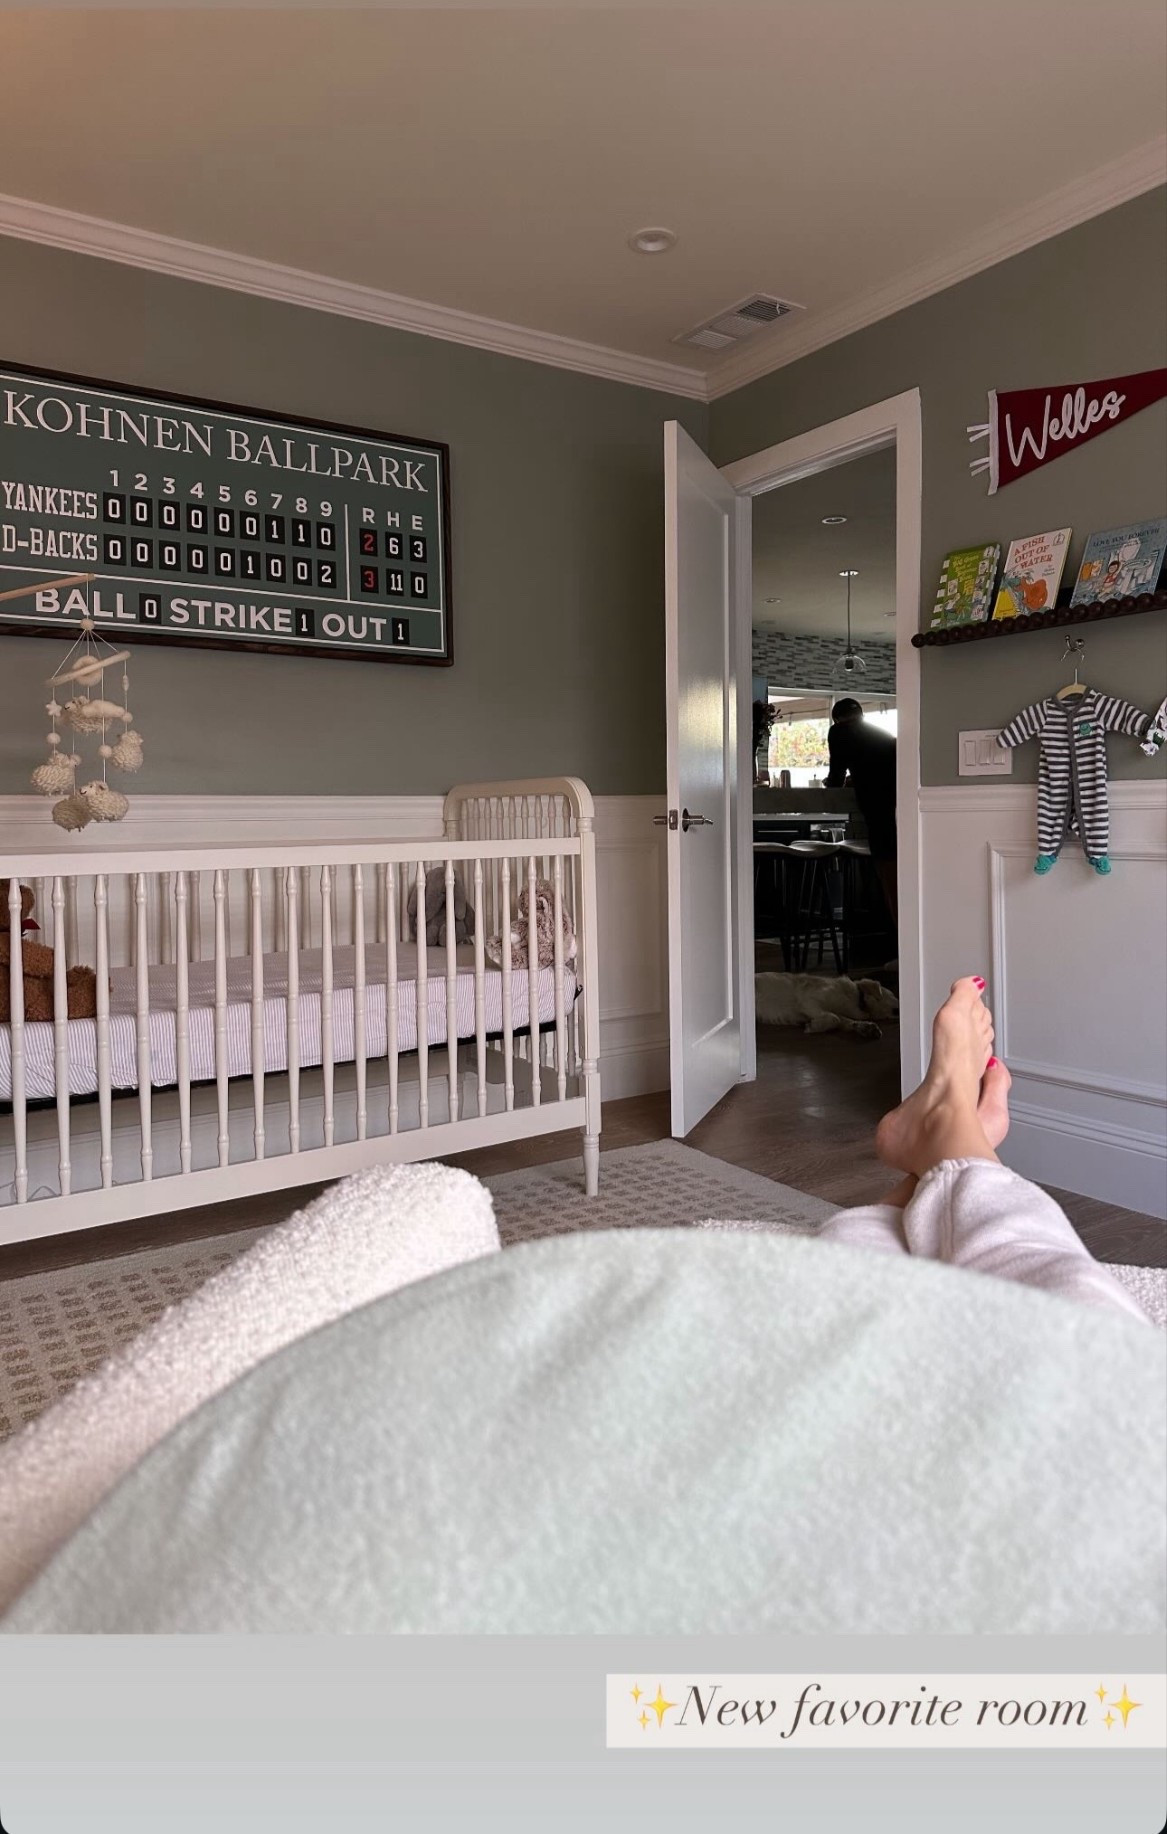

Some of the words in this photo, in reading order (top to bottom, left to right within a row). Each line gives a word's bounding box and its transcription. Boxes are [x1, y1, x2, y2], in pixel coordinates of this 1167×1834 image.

[3, 390, 214, 457] KOHNEN
[226, 429, 429, 493] BALLPARK
[1005, 387, 1127, 467] Welles
[2, 481, 98, 520] YANKEES
[109, 499, 120, 518] 0
[136, 503, 147, 521] 0
[164, 506, 175, 524] 0
[192, 510, 202, 528] 0
[219, 514, 229, 531] 0
[246, 517, 256, 535] 0
[271, 521, 279, 538] 1
[298, 525, 305, 542] 1
[321, 528, 331, 545] 0
[364, 532, 374, 551] 2
[390, 538, 398, 554] 6
[414, 541, 422, 557] 3
[110, 470, 118, 486] 1
[135, 474, 147, 490] 2
[163, 477, 175, 494] 3
[190, 483, 204, 498] 4
[219, 486, 230, 502] 5
[245, 490, 257, 505] 6
[271, 494, 282, 509] 7
[296, 498, 307, 513] 8
[321, 502, 332, 516] 9
[362, 508, 375, 524] R
[387, 512, 400, 528] H
[411, 515, 423, 531] E
[3, 525, 98, 561] D-BACKS
[109, 540, 121, 559] 0
[137, 543, 148, 561] 0
[165, 547, 175, 565] 0
[193, 550, 203, 568] 0
[221, 553, 231, 570] 0
[247, 556, 254, 573] 1
[271, 559, 281, 576] 0
[298, 563, 307, 579] 0
[321, 566, 331, 583] 2
[364, 571, 374, 588] 3
[390, 574, 403, 591] 11
[415, 577, 423, 593] 0
[1014, 548, 1020, 556] A
[1022, 536, 1045, 551] FISH
[1014, 550, 1034, 564] OUT
[1036, 544, 1050, 555] OF
[1020, 554, 1053, 569] WATER
[35, 588, 137, 620] BALL
[145, 599, 156, 618] 0
[169, 598, 292, 633] STRIKE
[301, 614, 308, 632] 1
[322, 613, 387, 641] OUT
[398, 623, 404, 641] 1
